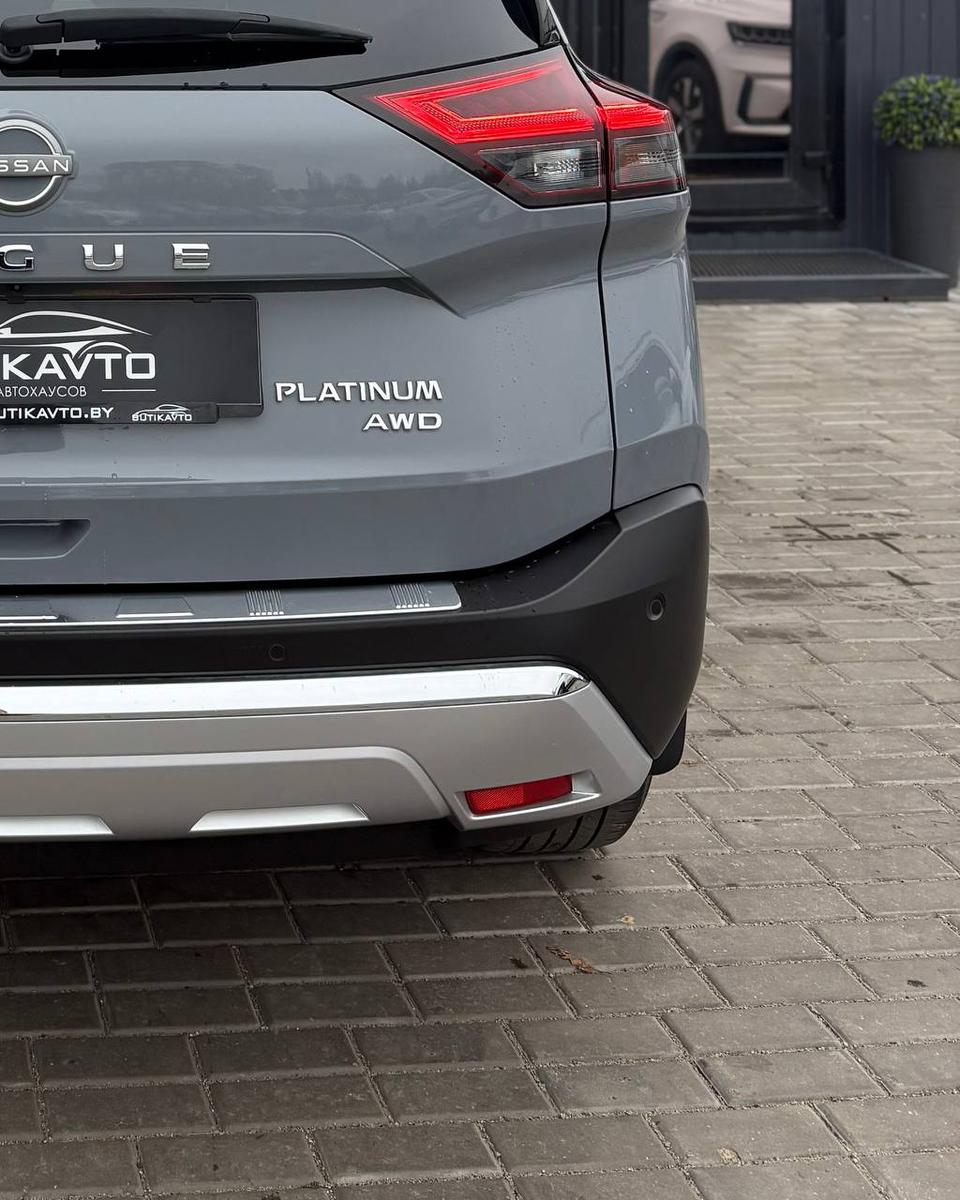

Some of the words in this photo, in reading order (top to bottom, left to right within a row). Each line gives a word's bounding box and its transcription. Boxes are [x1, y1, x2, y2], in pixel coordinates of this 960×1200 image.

[274, 379, 443, 403] PLATINUM
[131, 412, 193, 422] BUTIKAVTO
[362, 411, 443, 431] AWD
